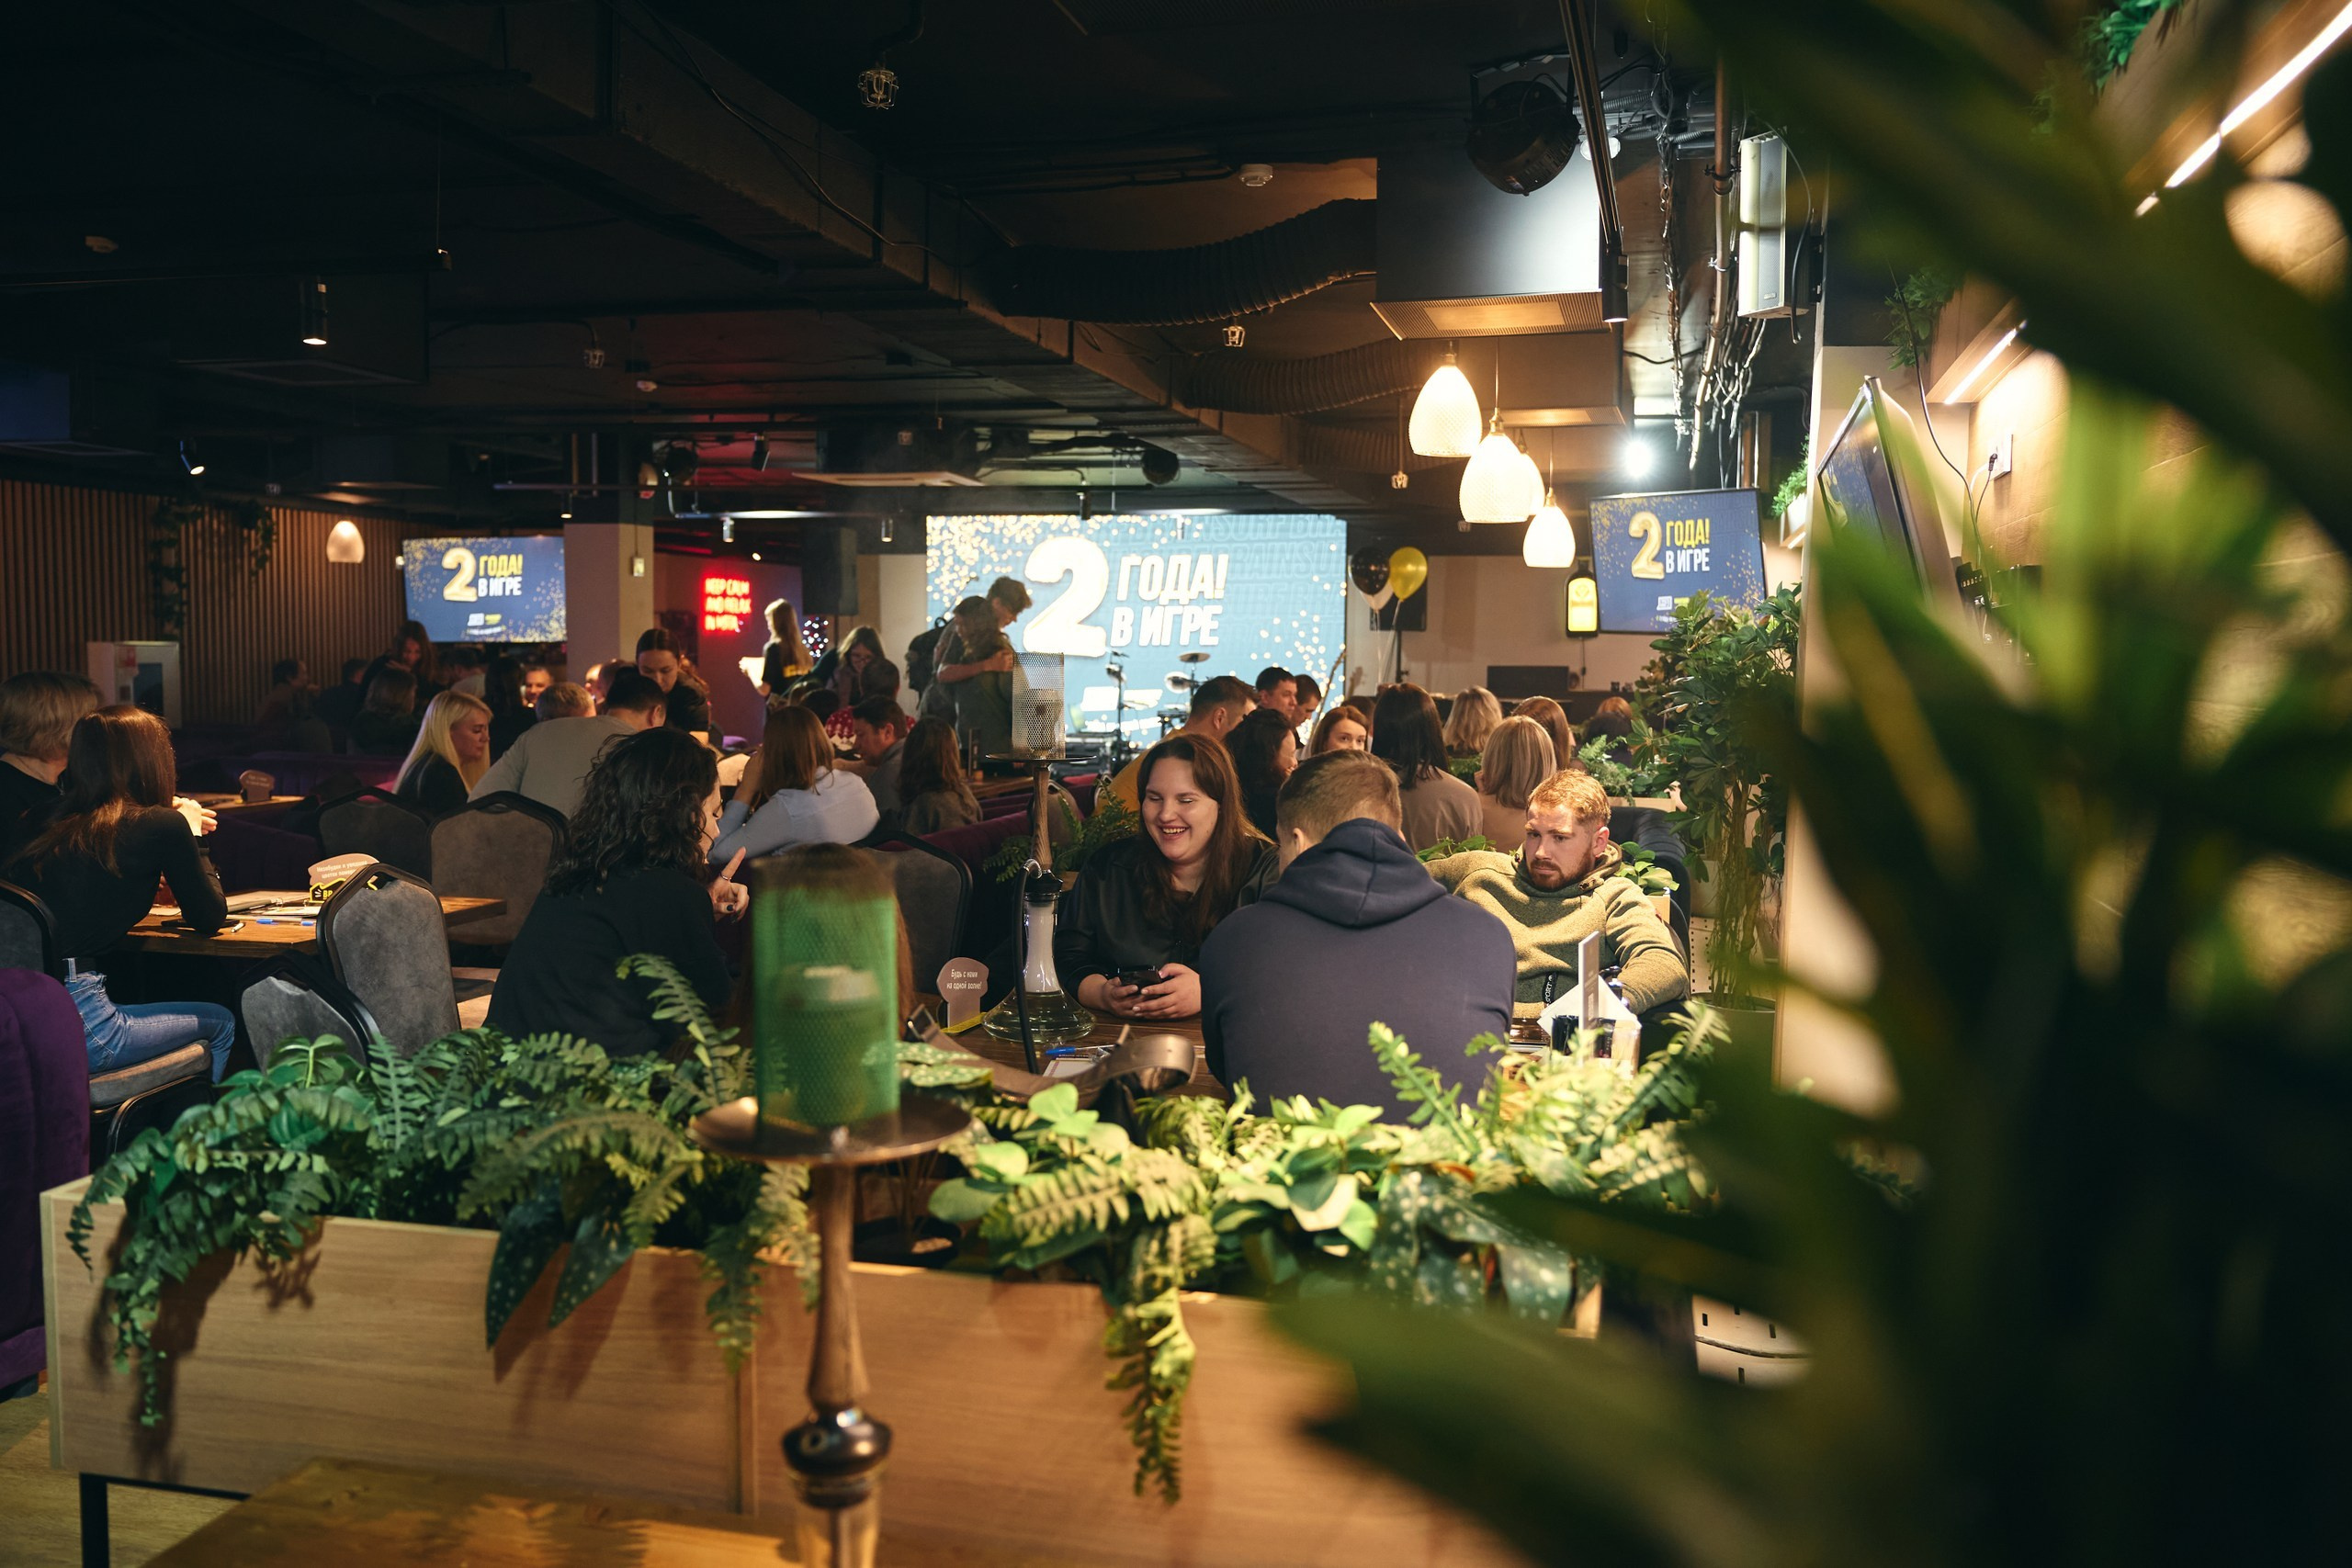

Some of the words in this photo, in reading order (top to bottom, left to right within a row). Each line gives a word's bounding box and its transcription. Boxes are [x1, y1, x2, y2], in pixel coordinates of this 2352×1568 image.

[1628, 511, 1666, 581] 2
[1666, 518, 1711, 548] ГОДА!
[1665, 550, 1675, 573] В
[1677, 548, 1711, 572] ИГРЕ
[441, 547, 479, 603] 2
[479, 553, 524, 577] ГОДА!
[478, 578, 488, 597] В
[490, 576, 523, 597] ИГРЕ
[1023, 536, 1109, 658] 2
[1117, 554, 1229, 605] ГОДА!
[1110, 606, 1135, 647] В
[1138, 605, 1223, 647] ИГРЕ
[951, 968, 962, 980] Будь
[953, 980, 967, 990] одной
[967, 981, 982, 989] волне!
